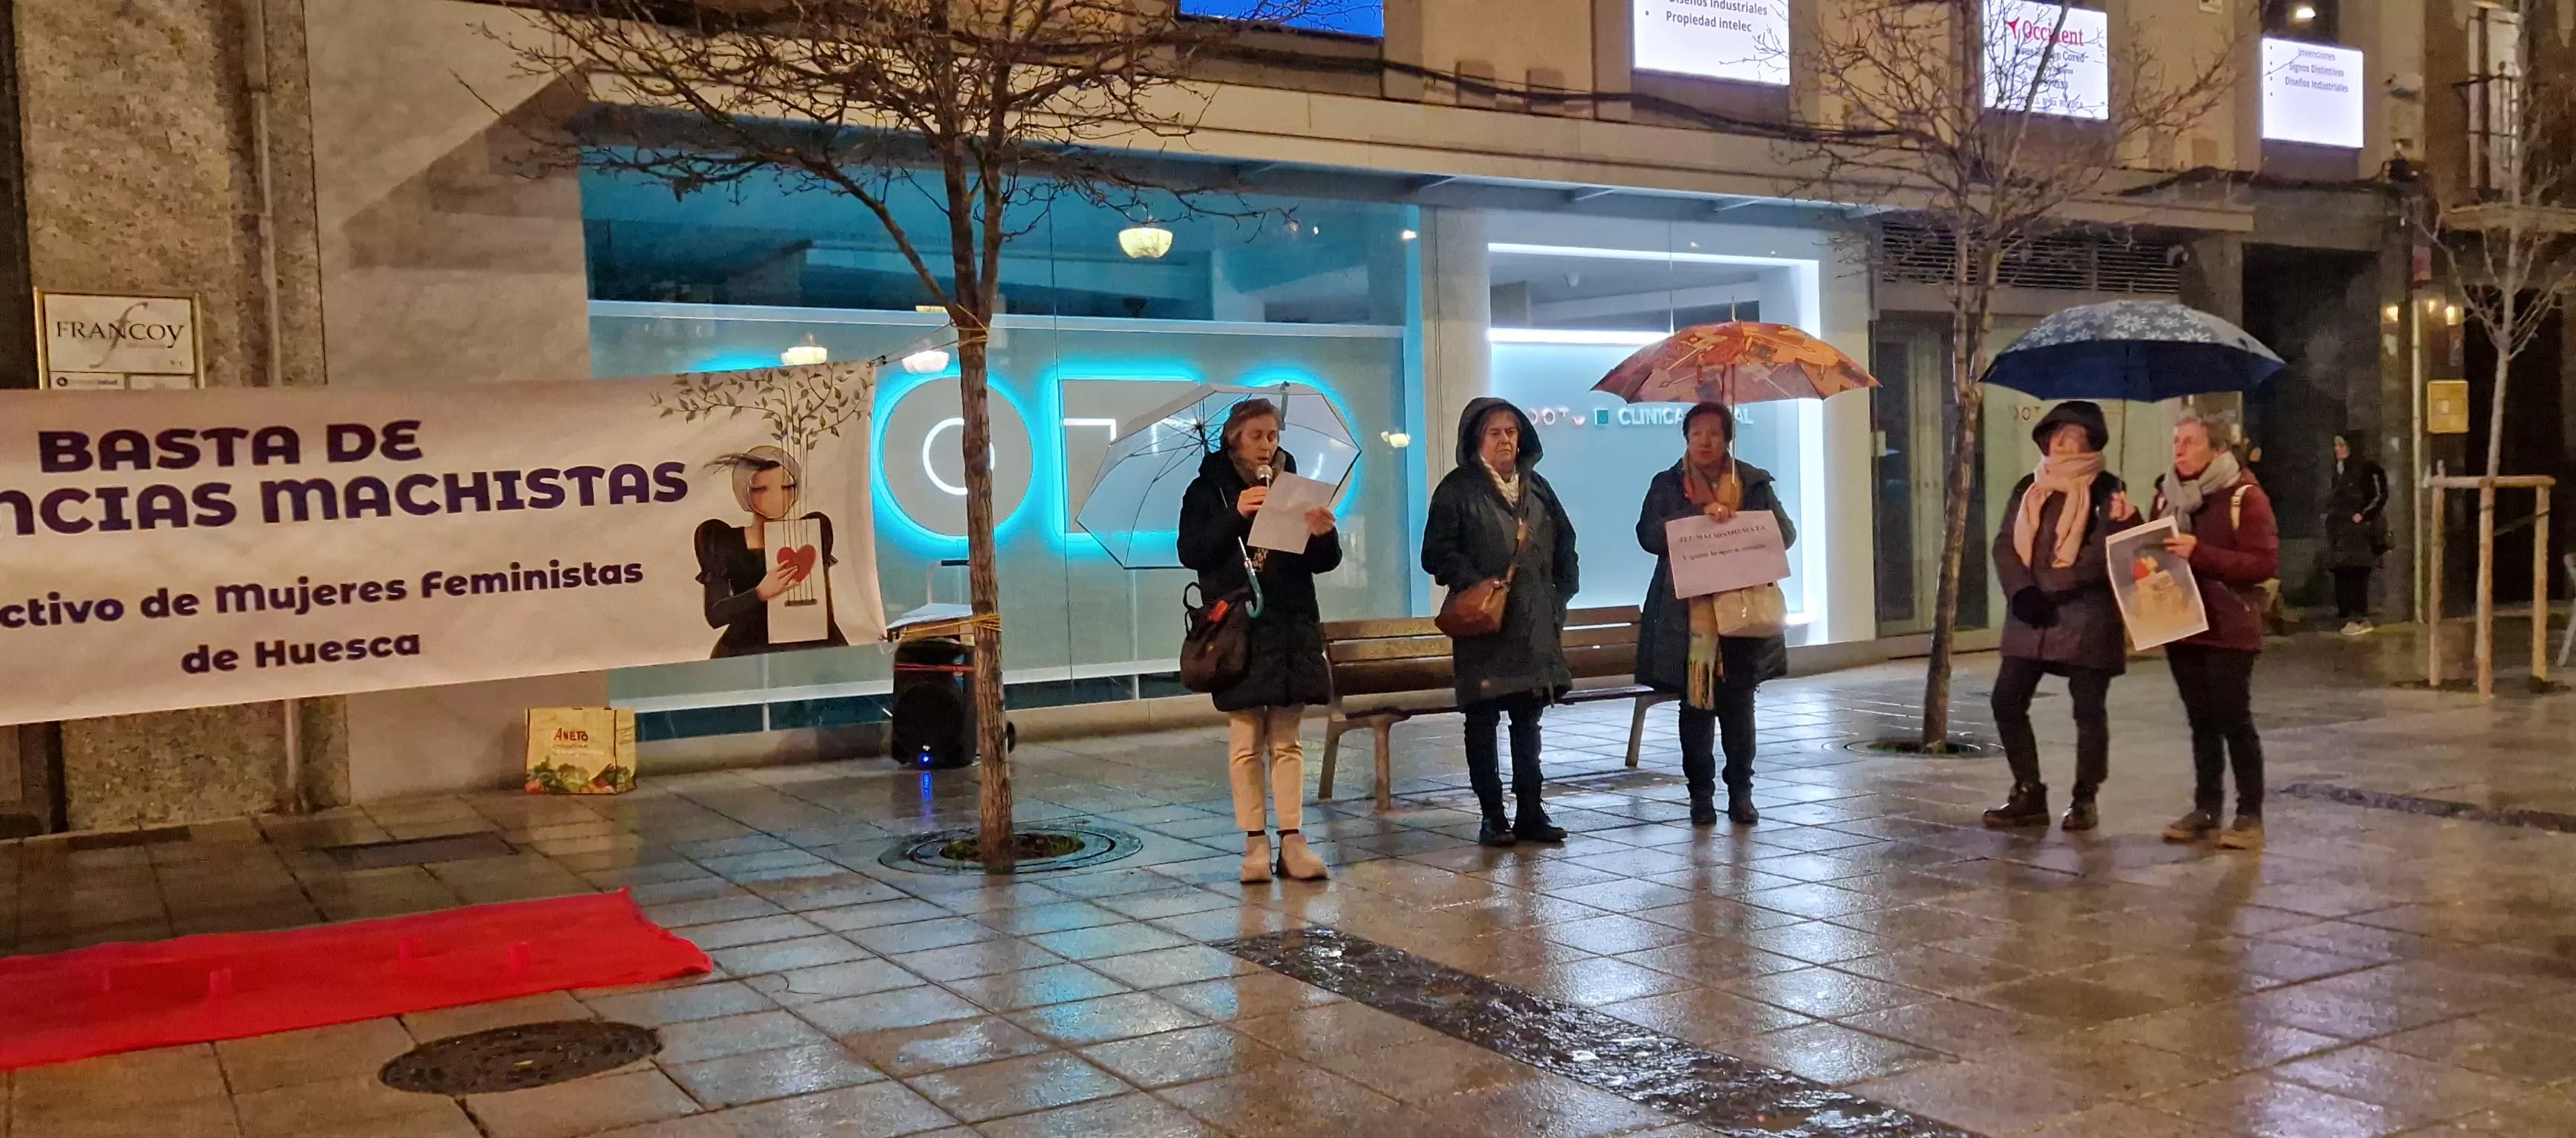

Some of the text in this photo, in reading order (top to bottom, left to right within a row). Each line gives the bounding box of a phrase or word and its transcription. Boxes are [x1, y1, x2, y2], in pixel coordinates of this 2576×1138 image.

[1710, 0, 1768, 15] Industriales
[1666, 11, 1753, 32] Propiedad intelec
[2022, 20, 2084, 46] Occient
[2299, 48, 2336, 61] Invenciones
[2289, 62, 2344, 77] Signos Distintivos
[2285, 76, 2349, 93] Diseños Industriales
[57, 321, 183, 348] FRANCOY
[1618, 407, 1684, 426] CLINICA
[38, 420, 424, 473] BASTA DE
[261, 461, 688, 524] MACHISTAS
[140, 588, 199, 618] de
[215, 576, 407, 615] Mujeres
[421, 560, 643, 599] Feministas
[181, 634, 420, 674] de Huesca
[554, 727, 589, 742] ANETO
